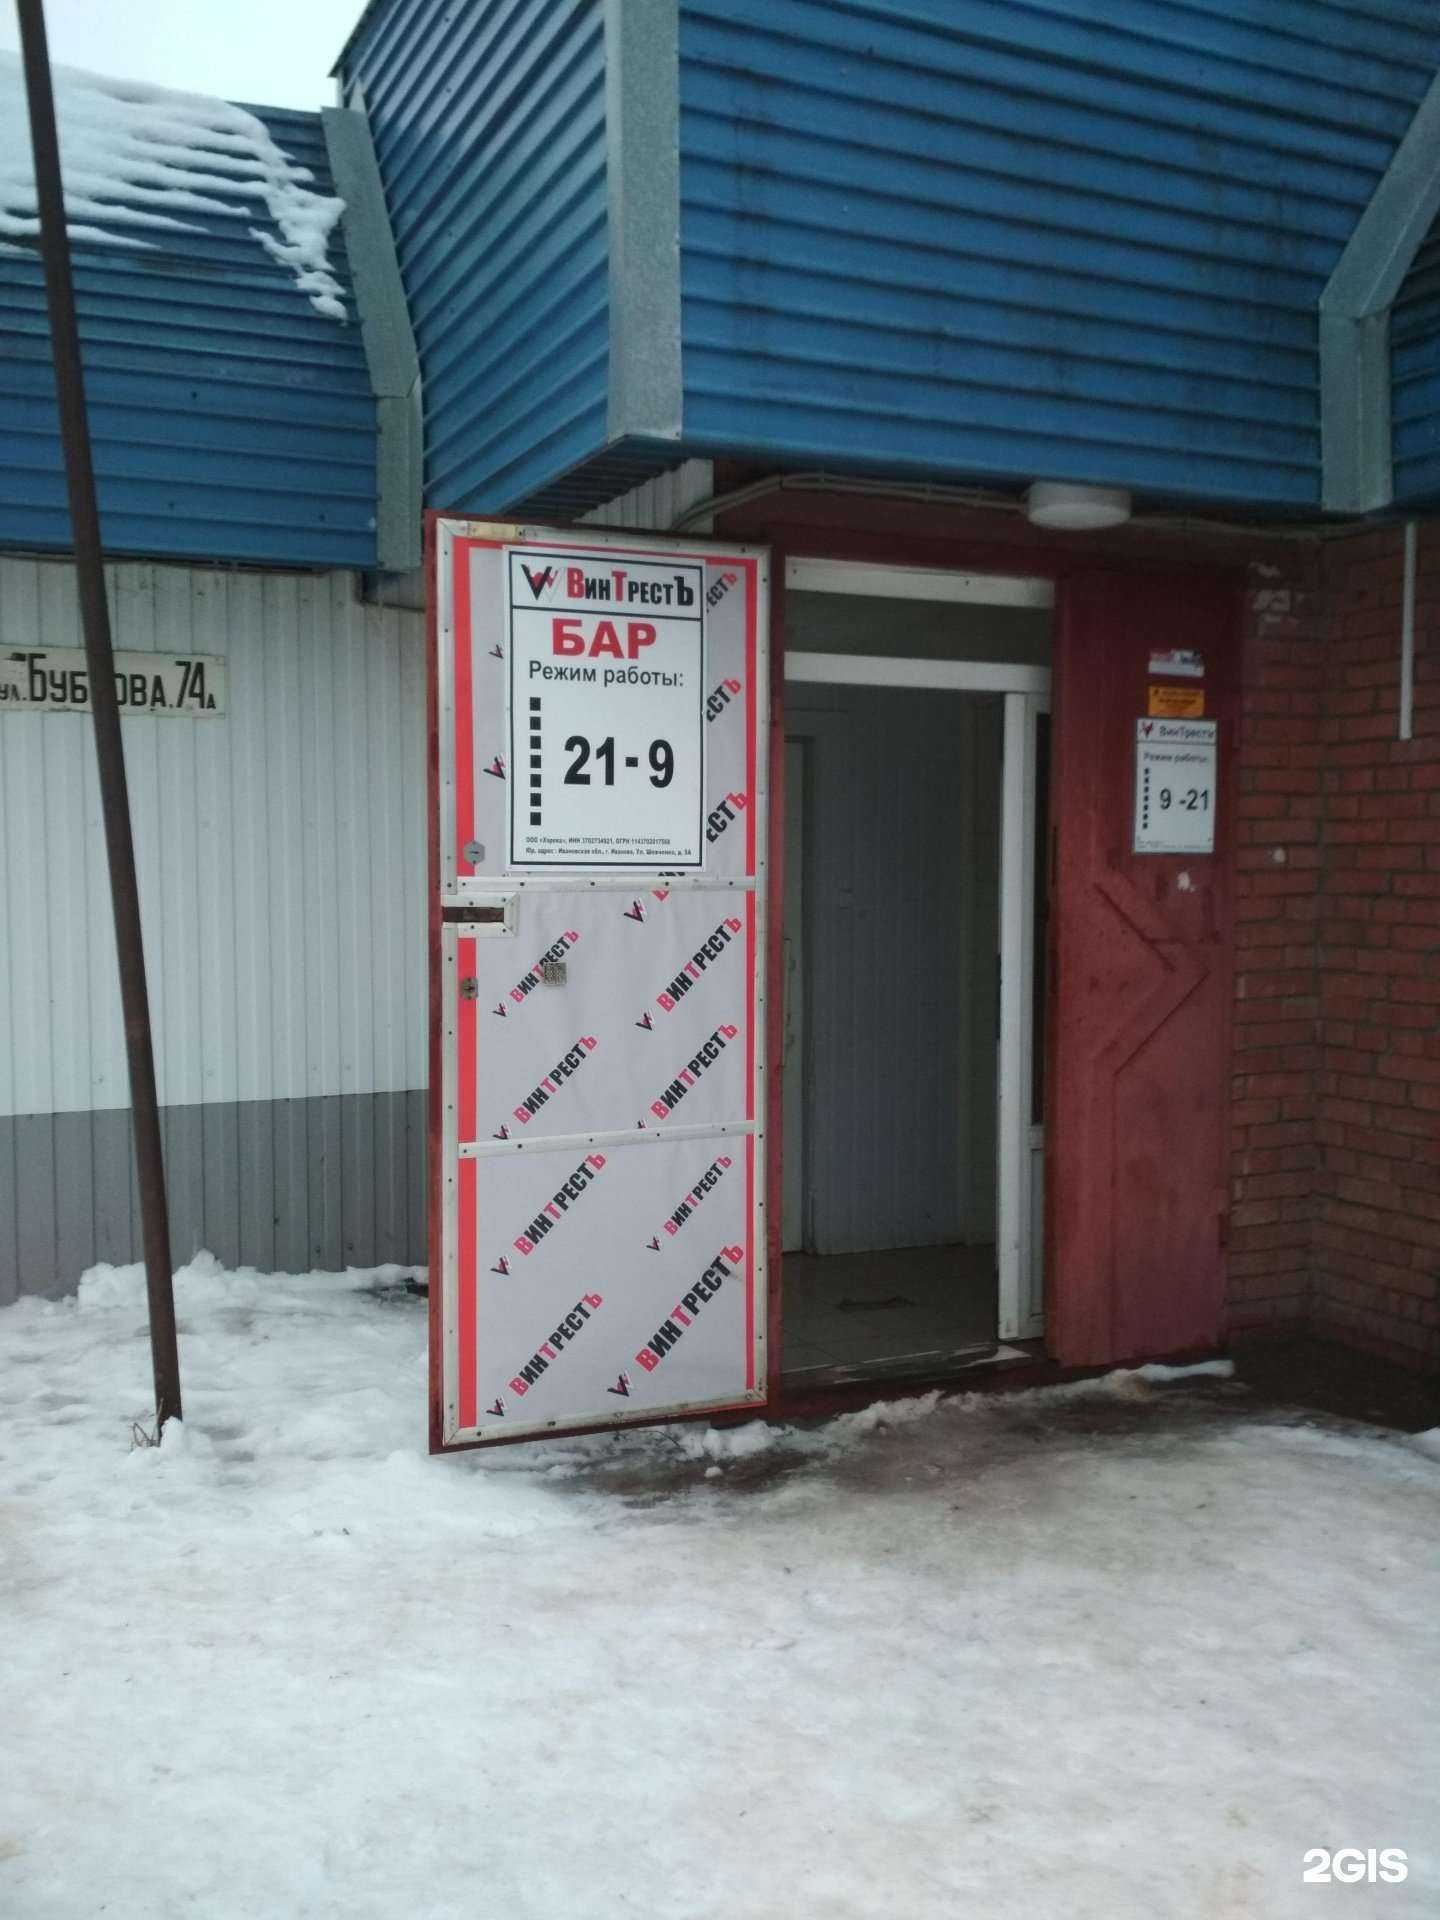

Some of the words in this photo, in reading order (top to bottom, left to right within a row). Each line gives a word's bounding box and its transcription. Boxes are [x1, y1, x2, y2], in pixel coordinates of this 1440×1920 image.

[552, 618, 657, 660] БАР
[529, 660, 597, 683] Режим
[604, 666, 684, 688] работы:
[563, 735, 675, 788] 21-9
